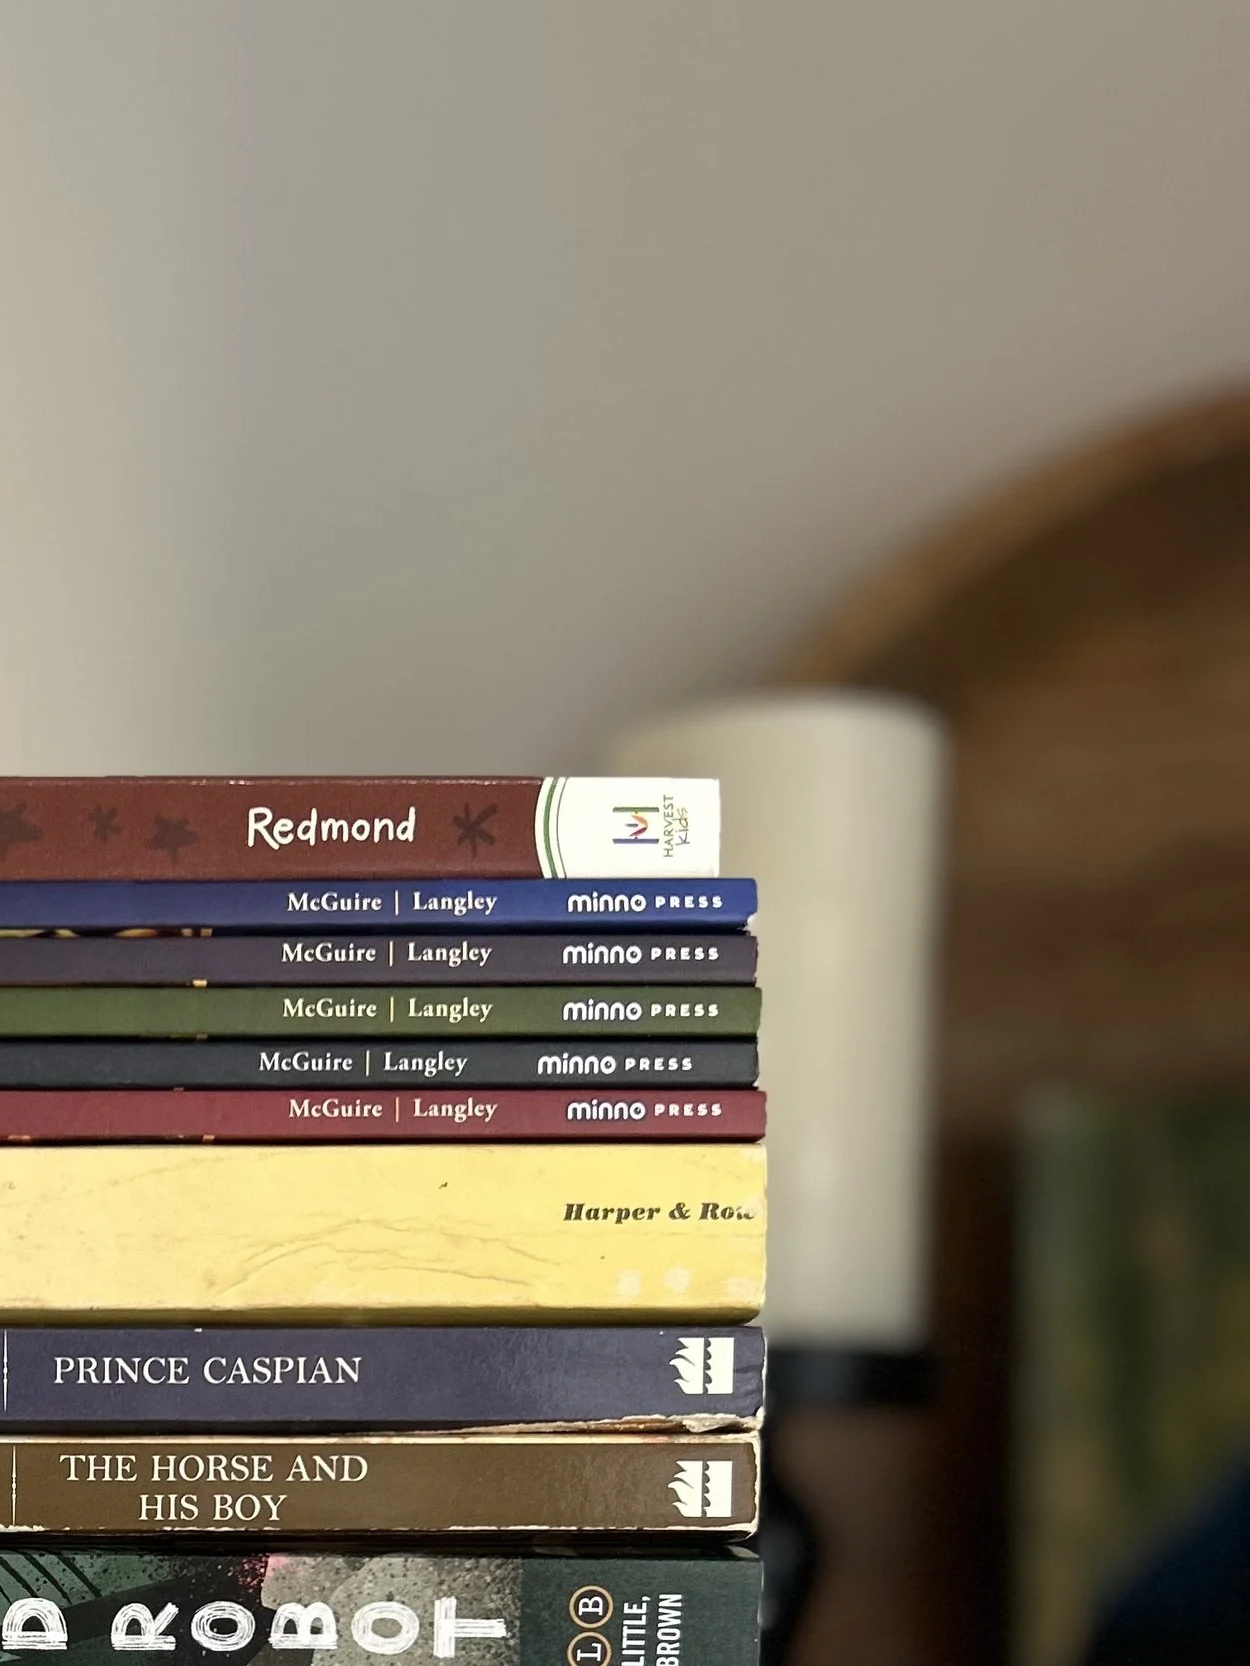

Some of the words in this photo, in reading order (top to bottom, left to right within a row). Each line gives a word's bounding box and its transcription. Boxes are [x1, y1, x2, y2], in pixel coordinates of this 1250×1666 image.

[248, 807, 416, 850] Redmond
[663, 794, 674, 858] HARVEST
[287, 891, 382, 912] McGuire
[413, 891, 497, 916] Langley
[567, 893, 646, 912] minno
[655, 895, 723, 909] PRESS
[259, 1052, 353, 1073] McGuire
[383, 1052, 468, 1076] Langley
[538, 1055, 616, 1074] minno
[625, 1057, 692, 1070] PRESS
[288, 1098, 383, 1120] McGuire
[413, 1098, 498, 1122] Langley
[567, 1101, 645, 1120] minno
[654, 1104, 722, 1116] PRESS
[563, 1203, 660, 1224] Harper
[668, 1203, 691, 1221] &
[54, 1356, 189, 1384] PRINCE
[203, 1357, 362, 1384] CASPIAN
[60, 1455, 137, 1482] THE
[151, 1455, 273, 1482] HORSE
[286, 1455, 368, 1482] AND
[138, 1494, 203, 1521] HIS
[214, 1495, 287, 1521] BOY
[111, 1597, 507, 1658] ROBOT
[621, 1596, 649, 1666] LITTLE,
